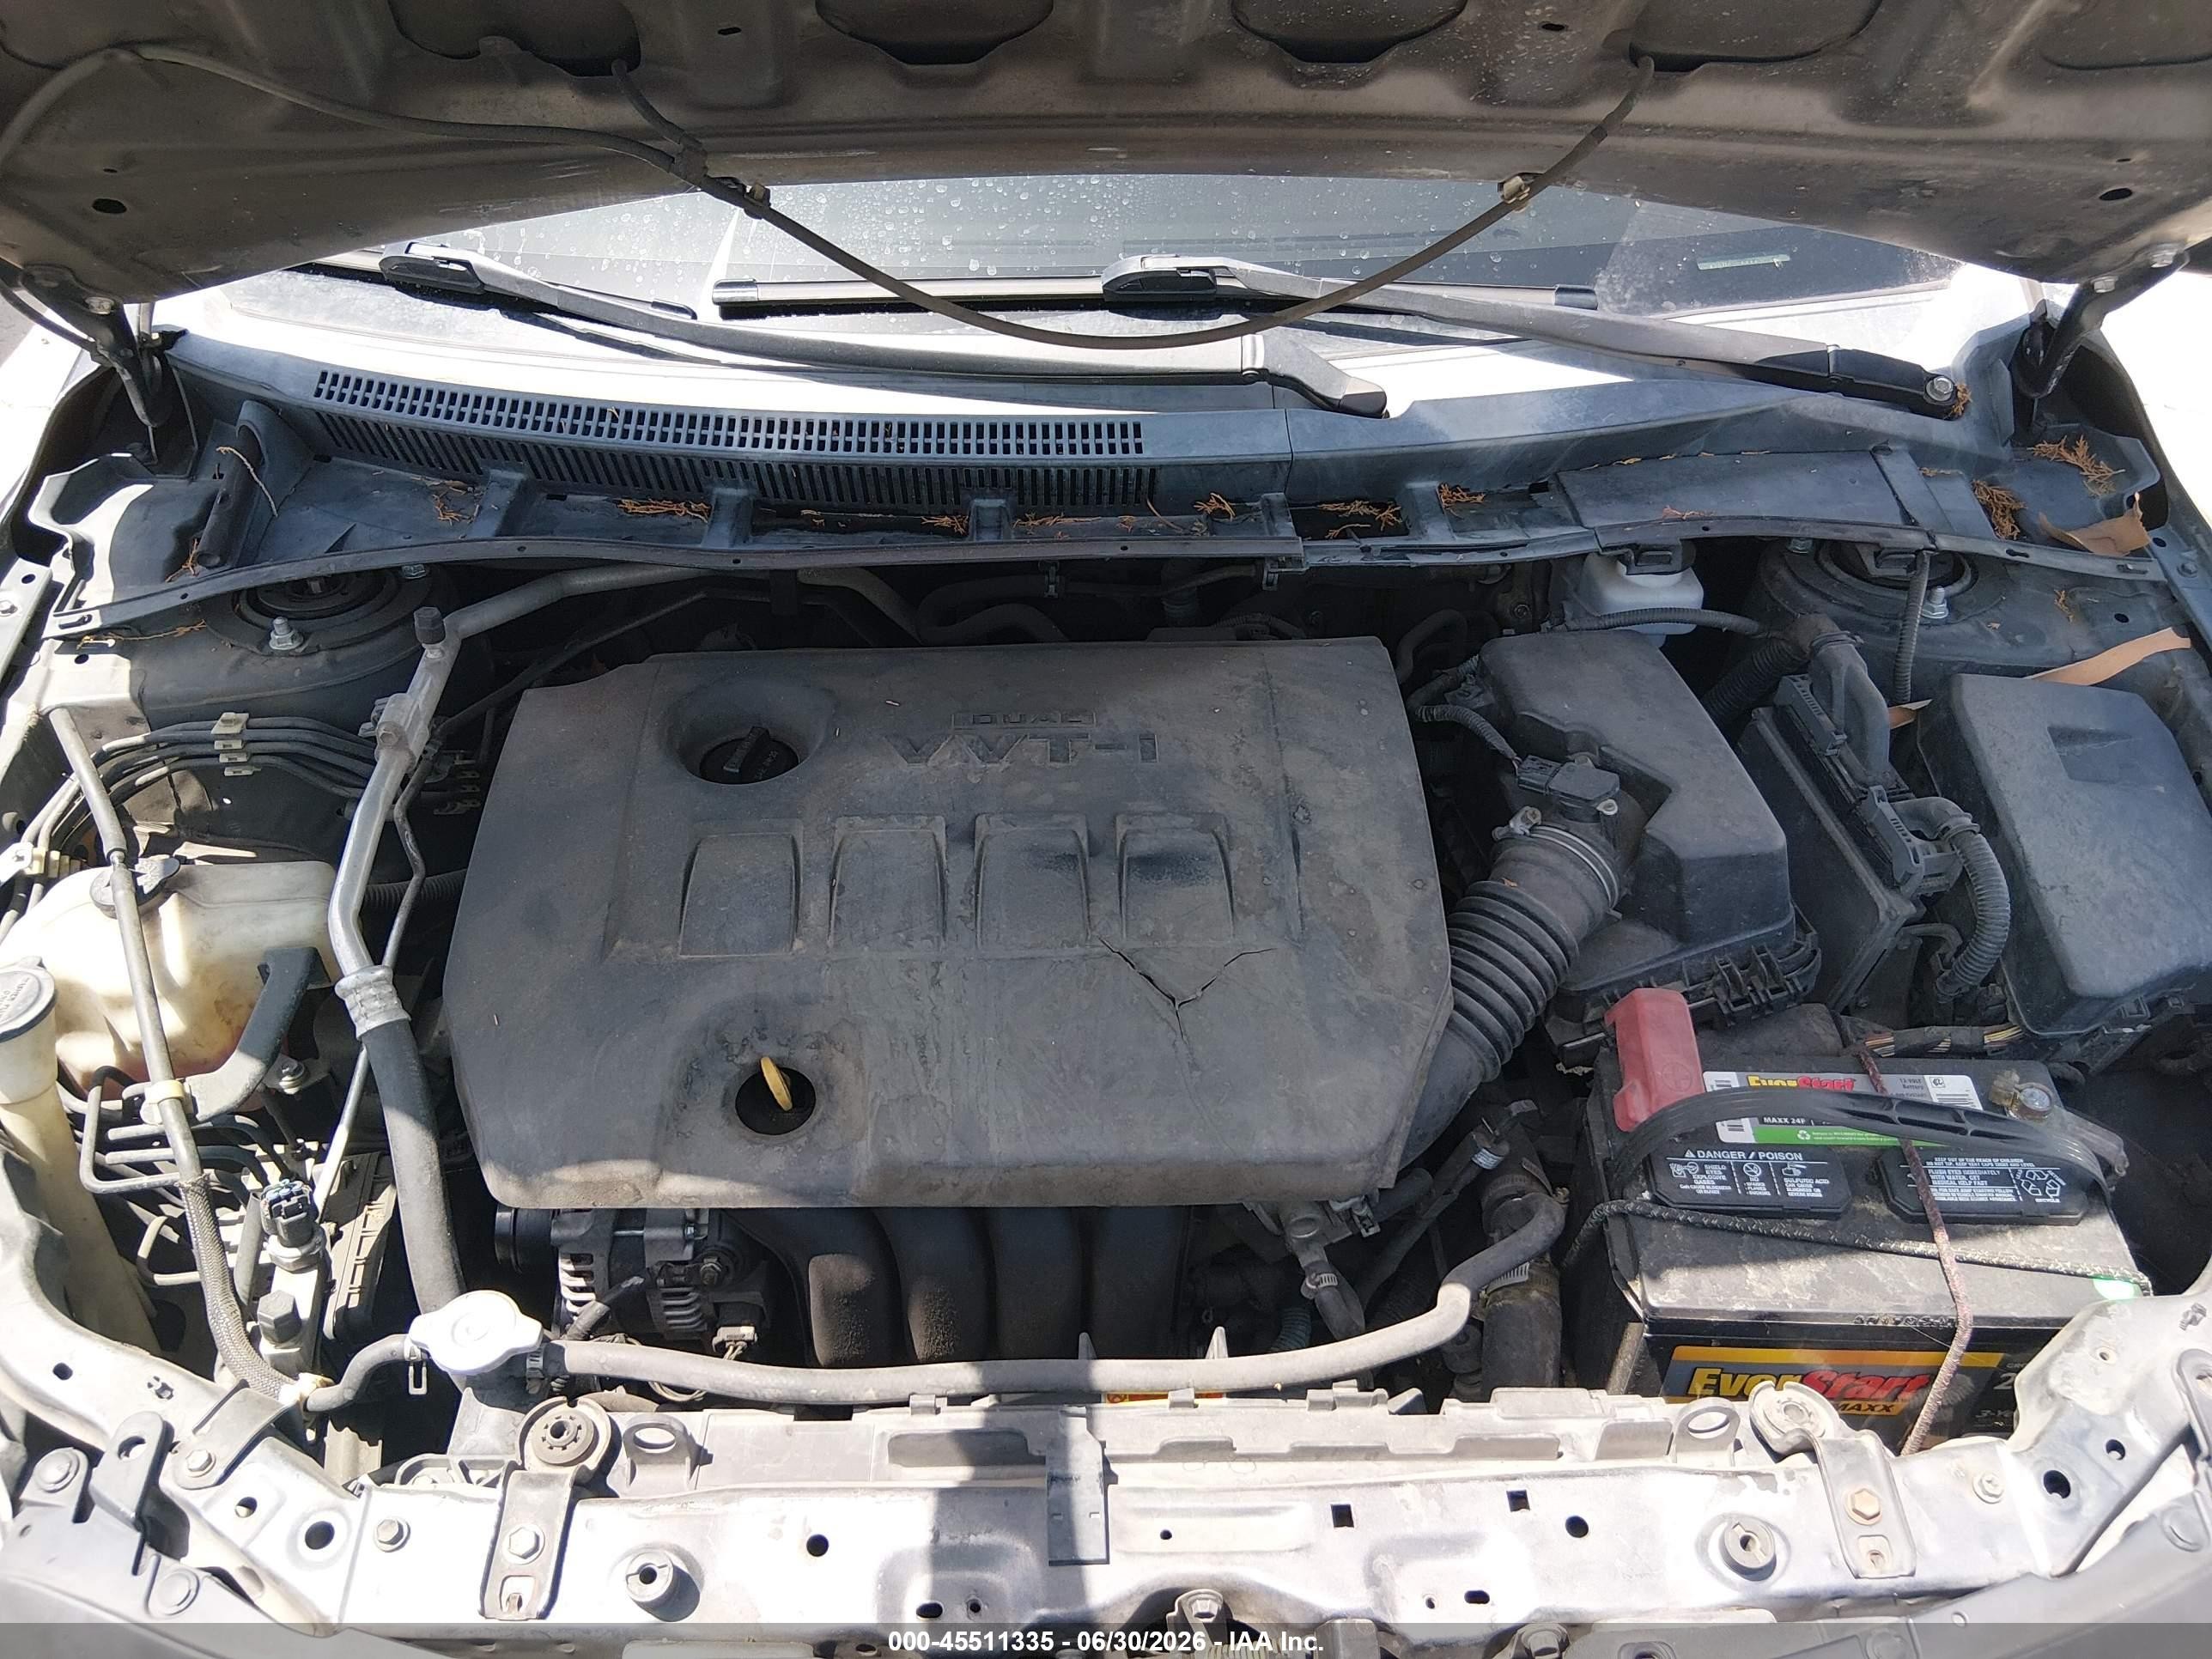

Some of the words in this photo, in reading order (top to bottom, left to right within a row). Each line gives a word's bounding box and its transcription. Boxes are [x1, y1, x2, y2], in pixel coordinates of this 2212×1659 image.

[1763, 1116, 1790, 1125] MAXX
[1697, 1150, 1747, 1159] DANGER
[1758, 1151, 1803, 1161] POISON
